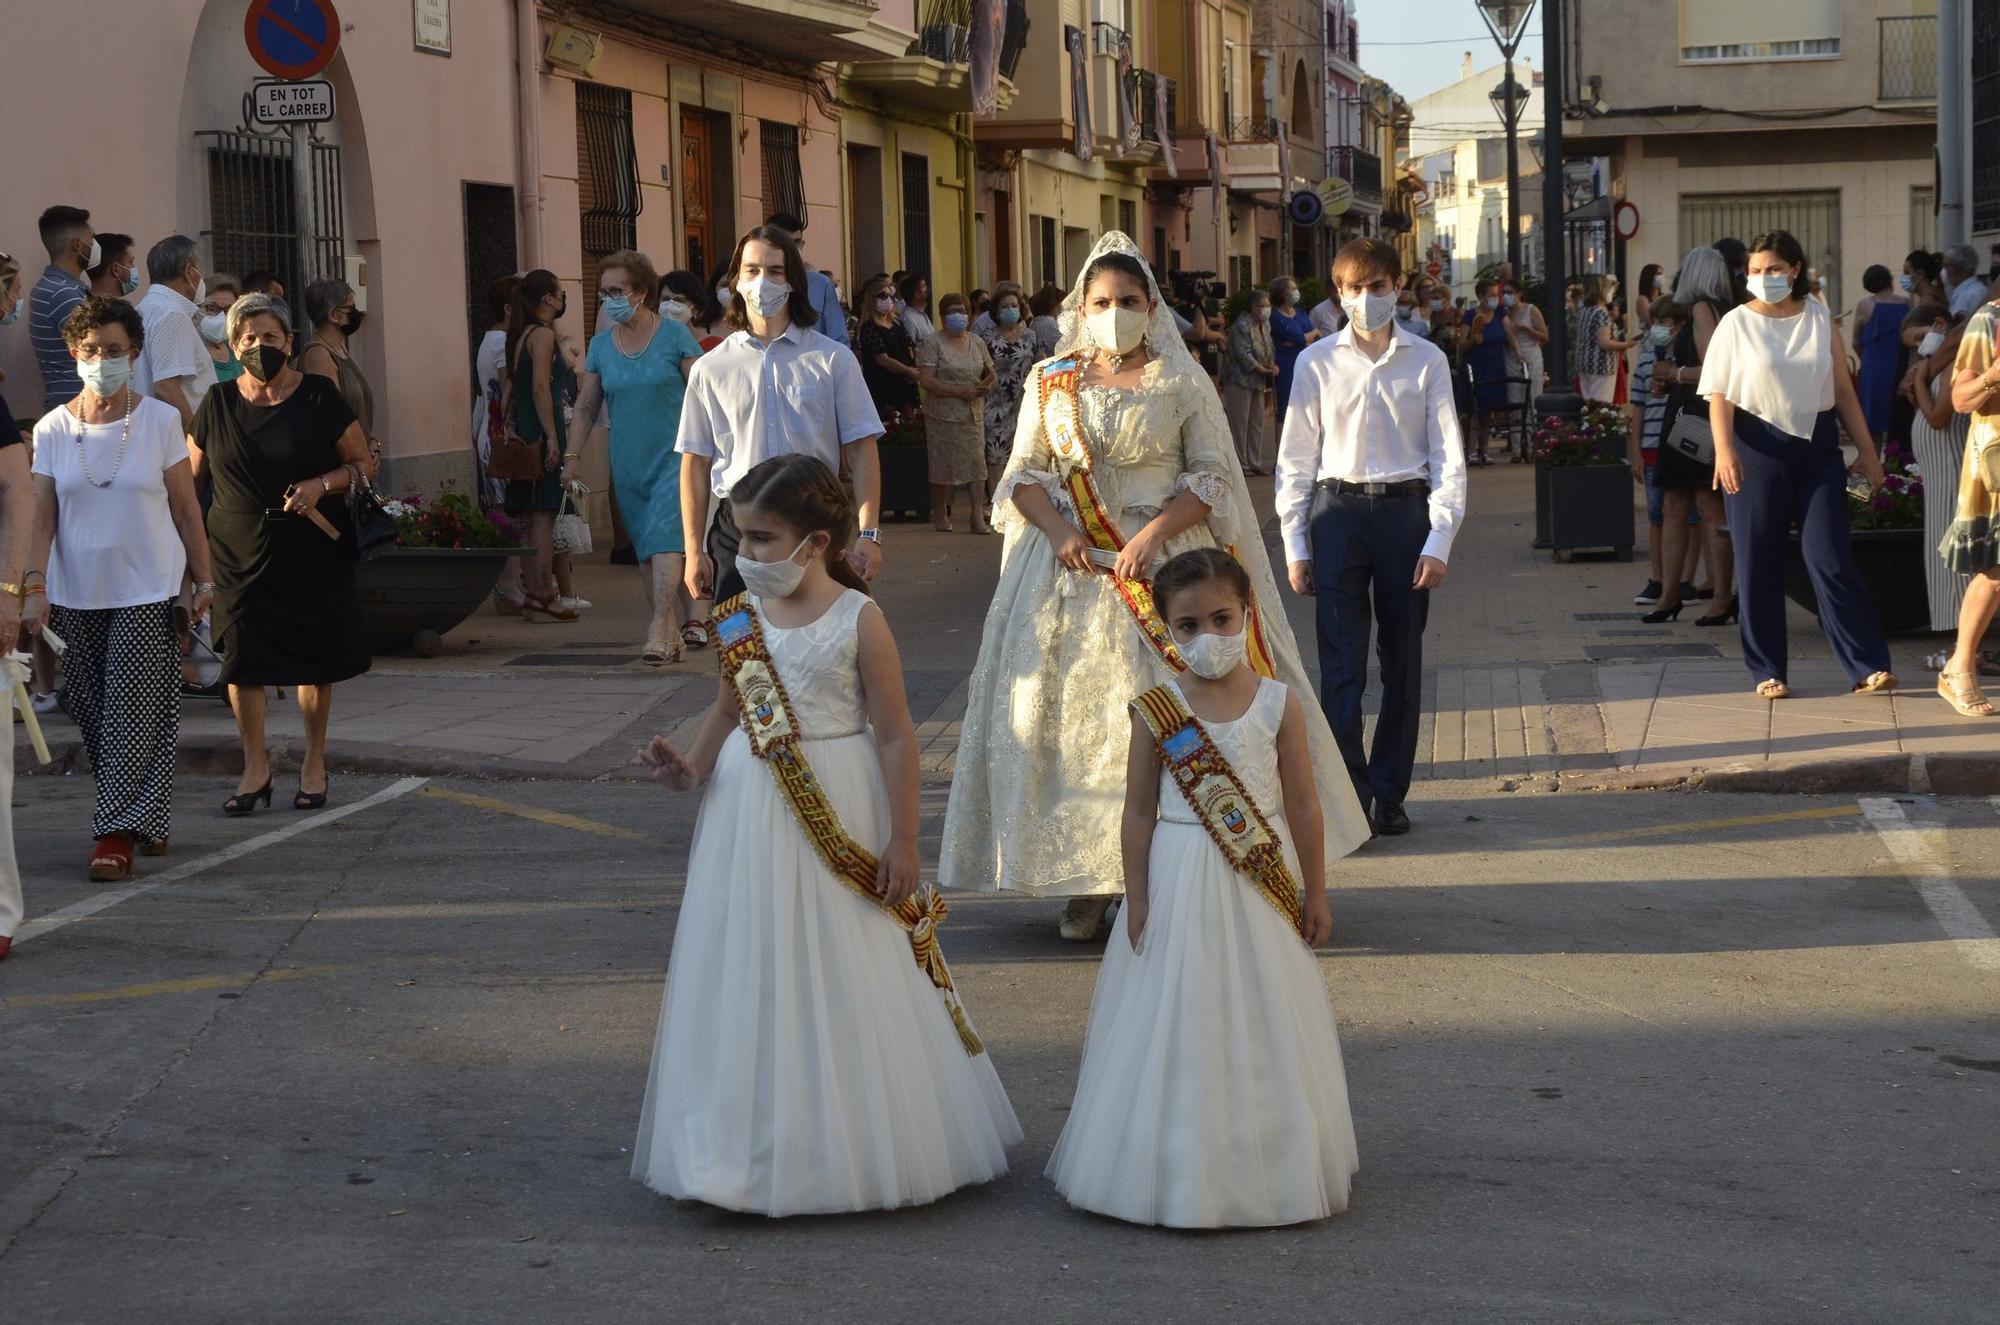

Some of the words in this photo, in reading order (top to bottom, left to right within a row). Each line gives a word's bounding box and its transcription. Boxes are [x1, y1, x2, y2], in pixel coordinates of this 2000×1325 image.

[270, 89, 286, 101] EN
[292, 88, 315, 99] TOT
[260, 105, 274, 117] EL
[279, 103, 327, 116] CARRER
